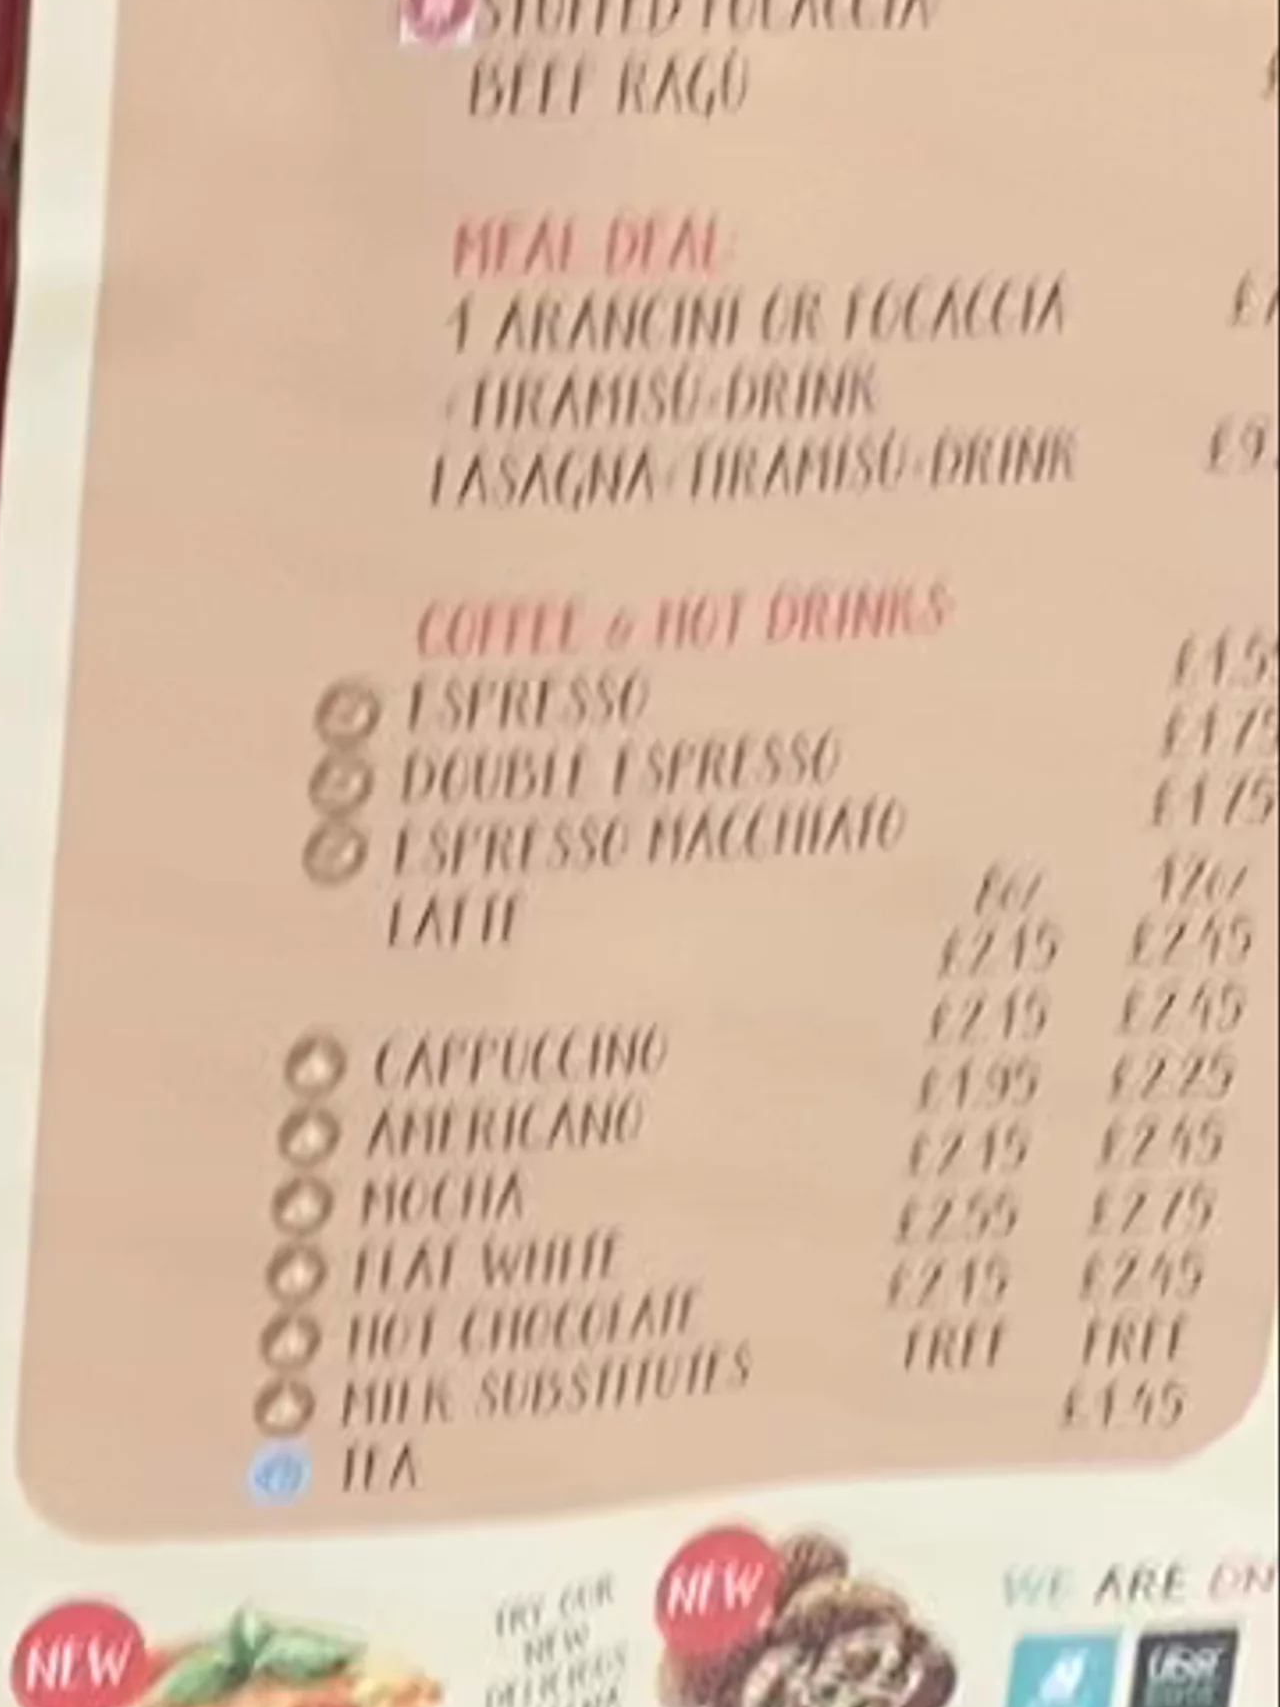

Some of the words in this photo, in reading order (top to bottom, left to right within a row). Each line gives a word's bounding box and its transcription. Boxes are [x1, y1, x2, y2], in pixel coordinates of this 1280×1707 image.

[469, 51, 586, 117] BEEF
[452, 207, 580, 280] MEAL
[607, 205, 726, 280] DEAL
[496, 283, 742, 354] ARANCINI
[760, 279, 824, 342] OR
[844, 270, 1069, 343] FOCACCIA
[416, 595, 581, 660] COFFEE
[653, 587, 746, 652] HOT
[764, 577, 950, 646] DRINKS
[407, 668, 649, 734] ESPRESSO
[401, 740, 589, 806] DOUBLE
[609, 726, 843, 797] ESPRESSO
[394, 812, 631, 878] ESPRESSO
[646, 792, 908, 867] MACCHIATO
[387, 890, 525, 951] LATTE
[374, 1024, 670, 1091] CAPPUCCINO
[366, 1092, 644, 1160] AMERICANO
[360, 1168, 525, 1227] MOCHA
[353, 1235, 459, 1295] FLAT
[481, 1226, 626, 1290] WHITE
[347, 1305, 437, 1363] HOT
[459, 1284, 703, 1360] CHOCOLATE
[341, 1375, 452, 1430] MILK
[342, 1438, 424, 1493] TEA
[665, 1553, 767, 1623] NEW
[1093, 1558, 1185, 1607] ARE
[24, 1633, 132, 1695] NEW
